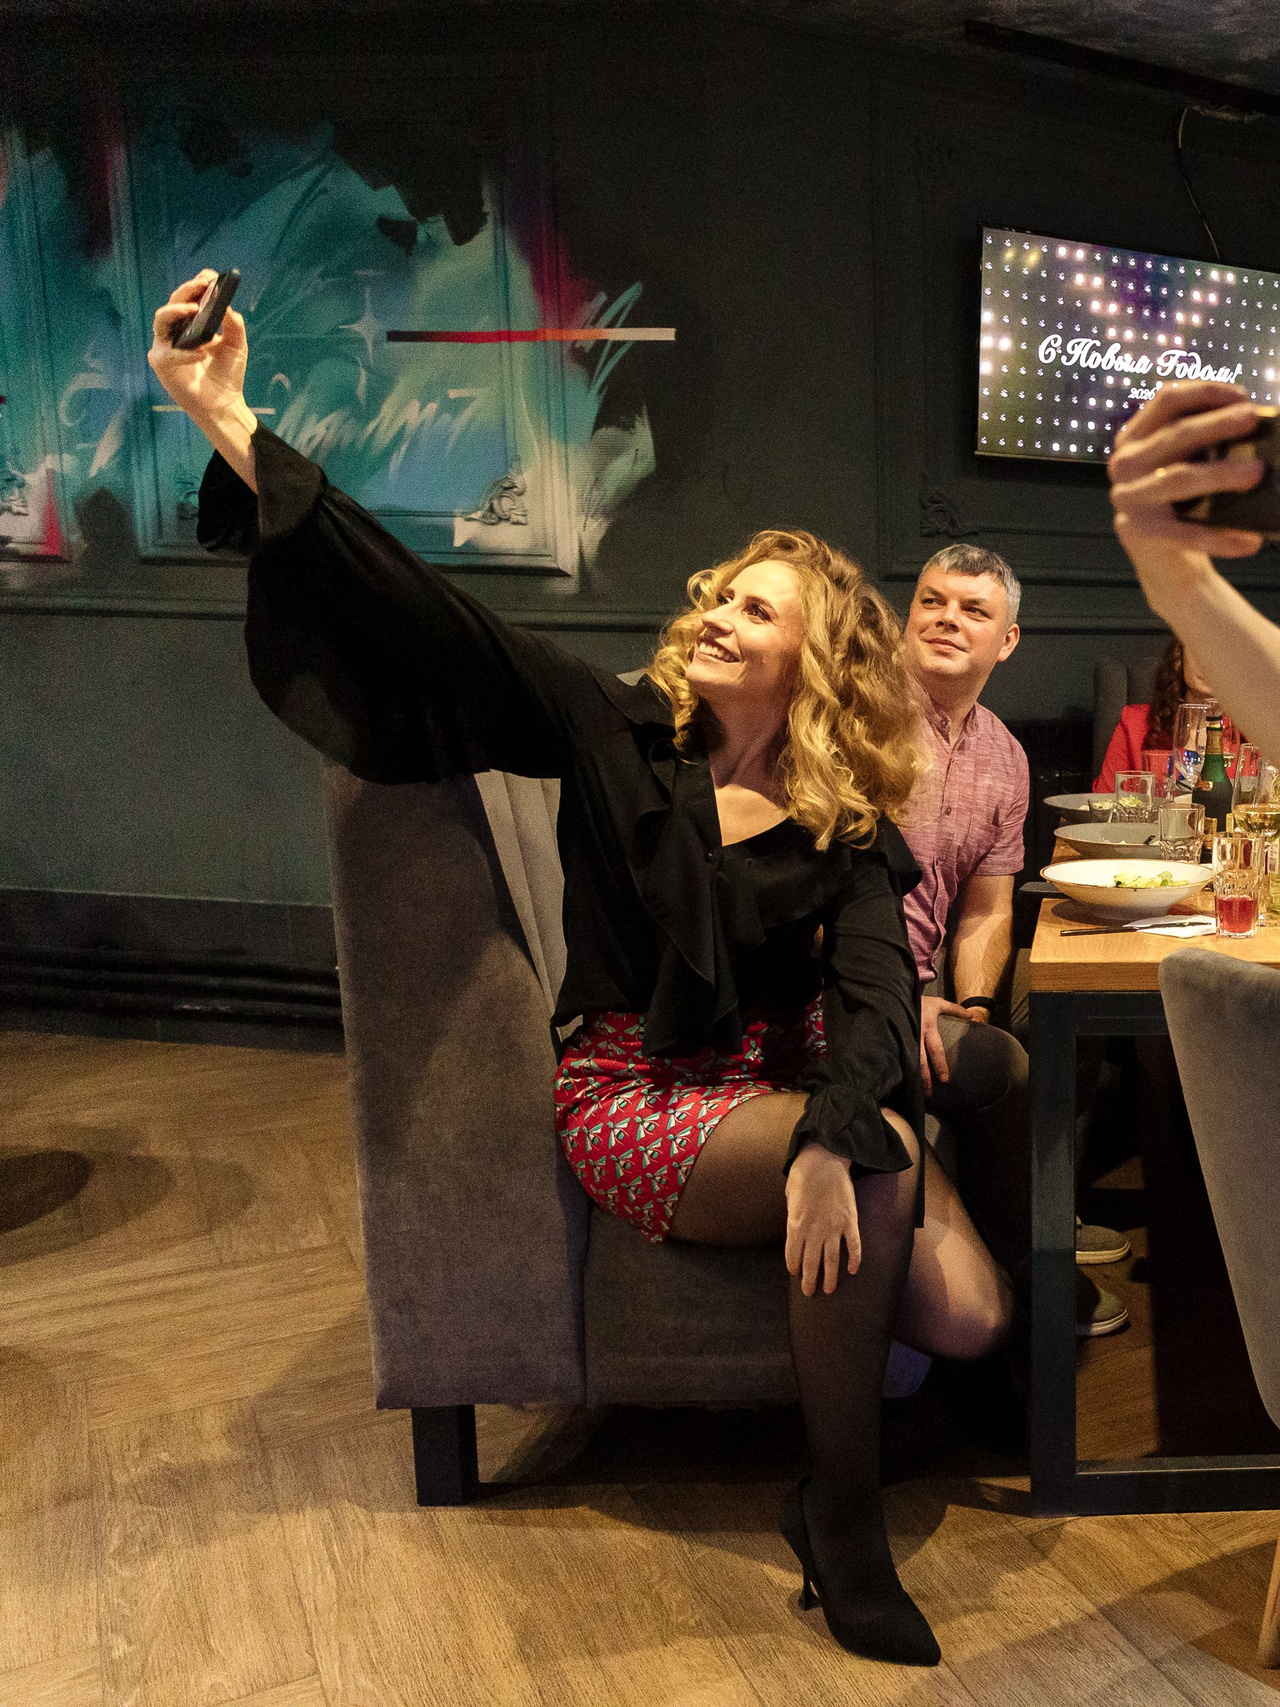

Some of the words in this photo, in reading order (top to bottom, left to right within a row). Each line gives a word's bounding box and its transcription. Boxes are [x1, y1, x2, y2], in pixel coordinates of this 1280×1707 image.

[1038, 333, 1063, 364] С
[1060, 337, 1154, 375] Новым
[1156, 349, 1243, 384] Годом!
